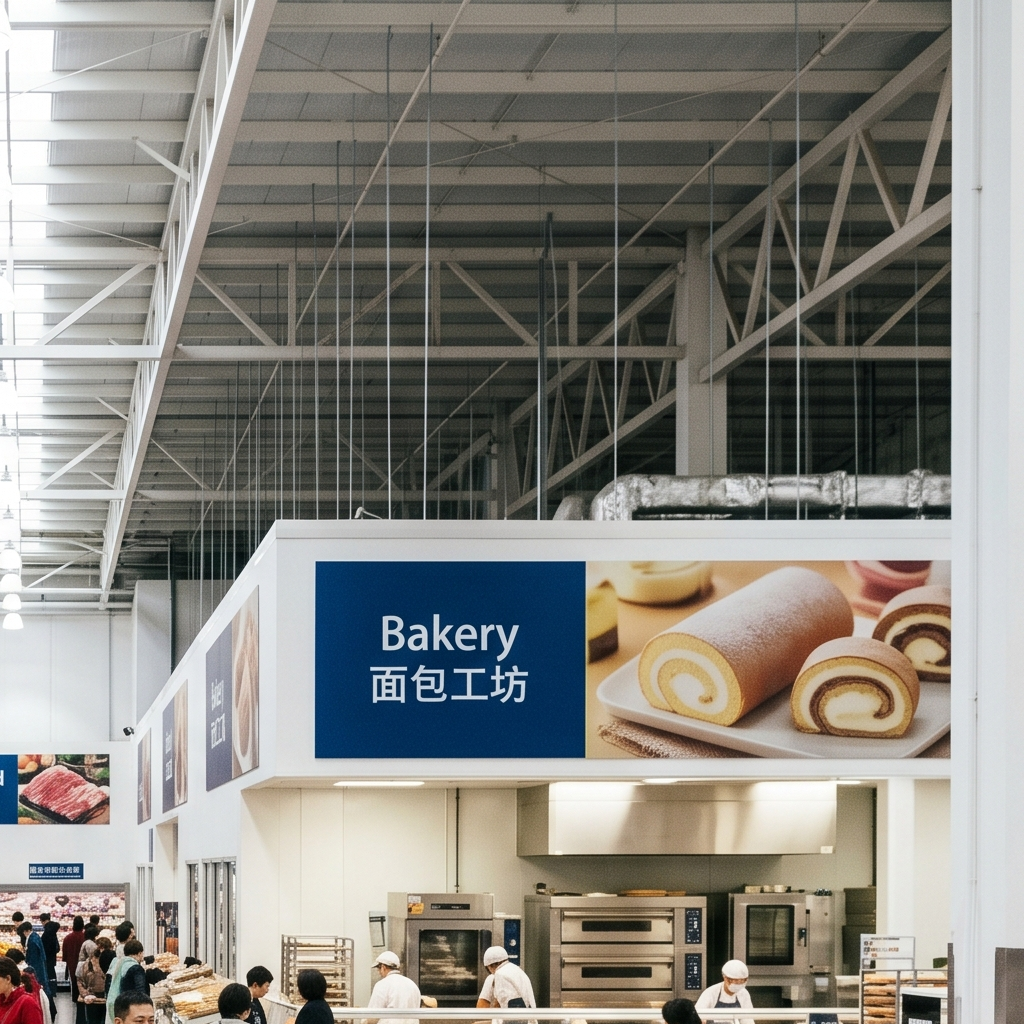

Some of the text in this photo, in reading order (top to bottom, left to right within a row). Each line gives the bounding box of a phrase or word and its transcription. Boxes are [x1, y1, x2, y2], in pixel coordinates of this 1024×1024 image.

[382, 613, 520, 662] Bakery
[369, 664, 529, 704] 面包工坊
